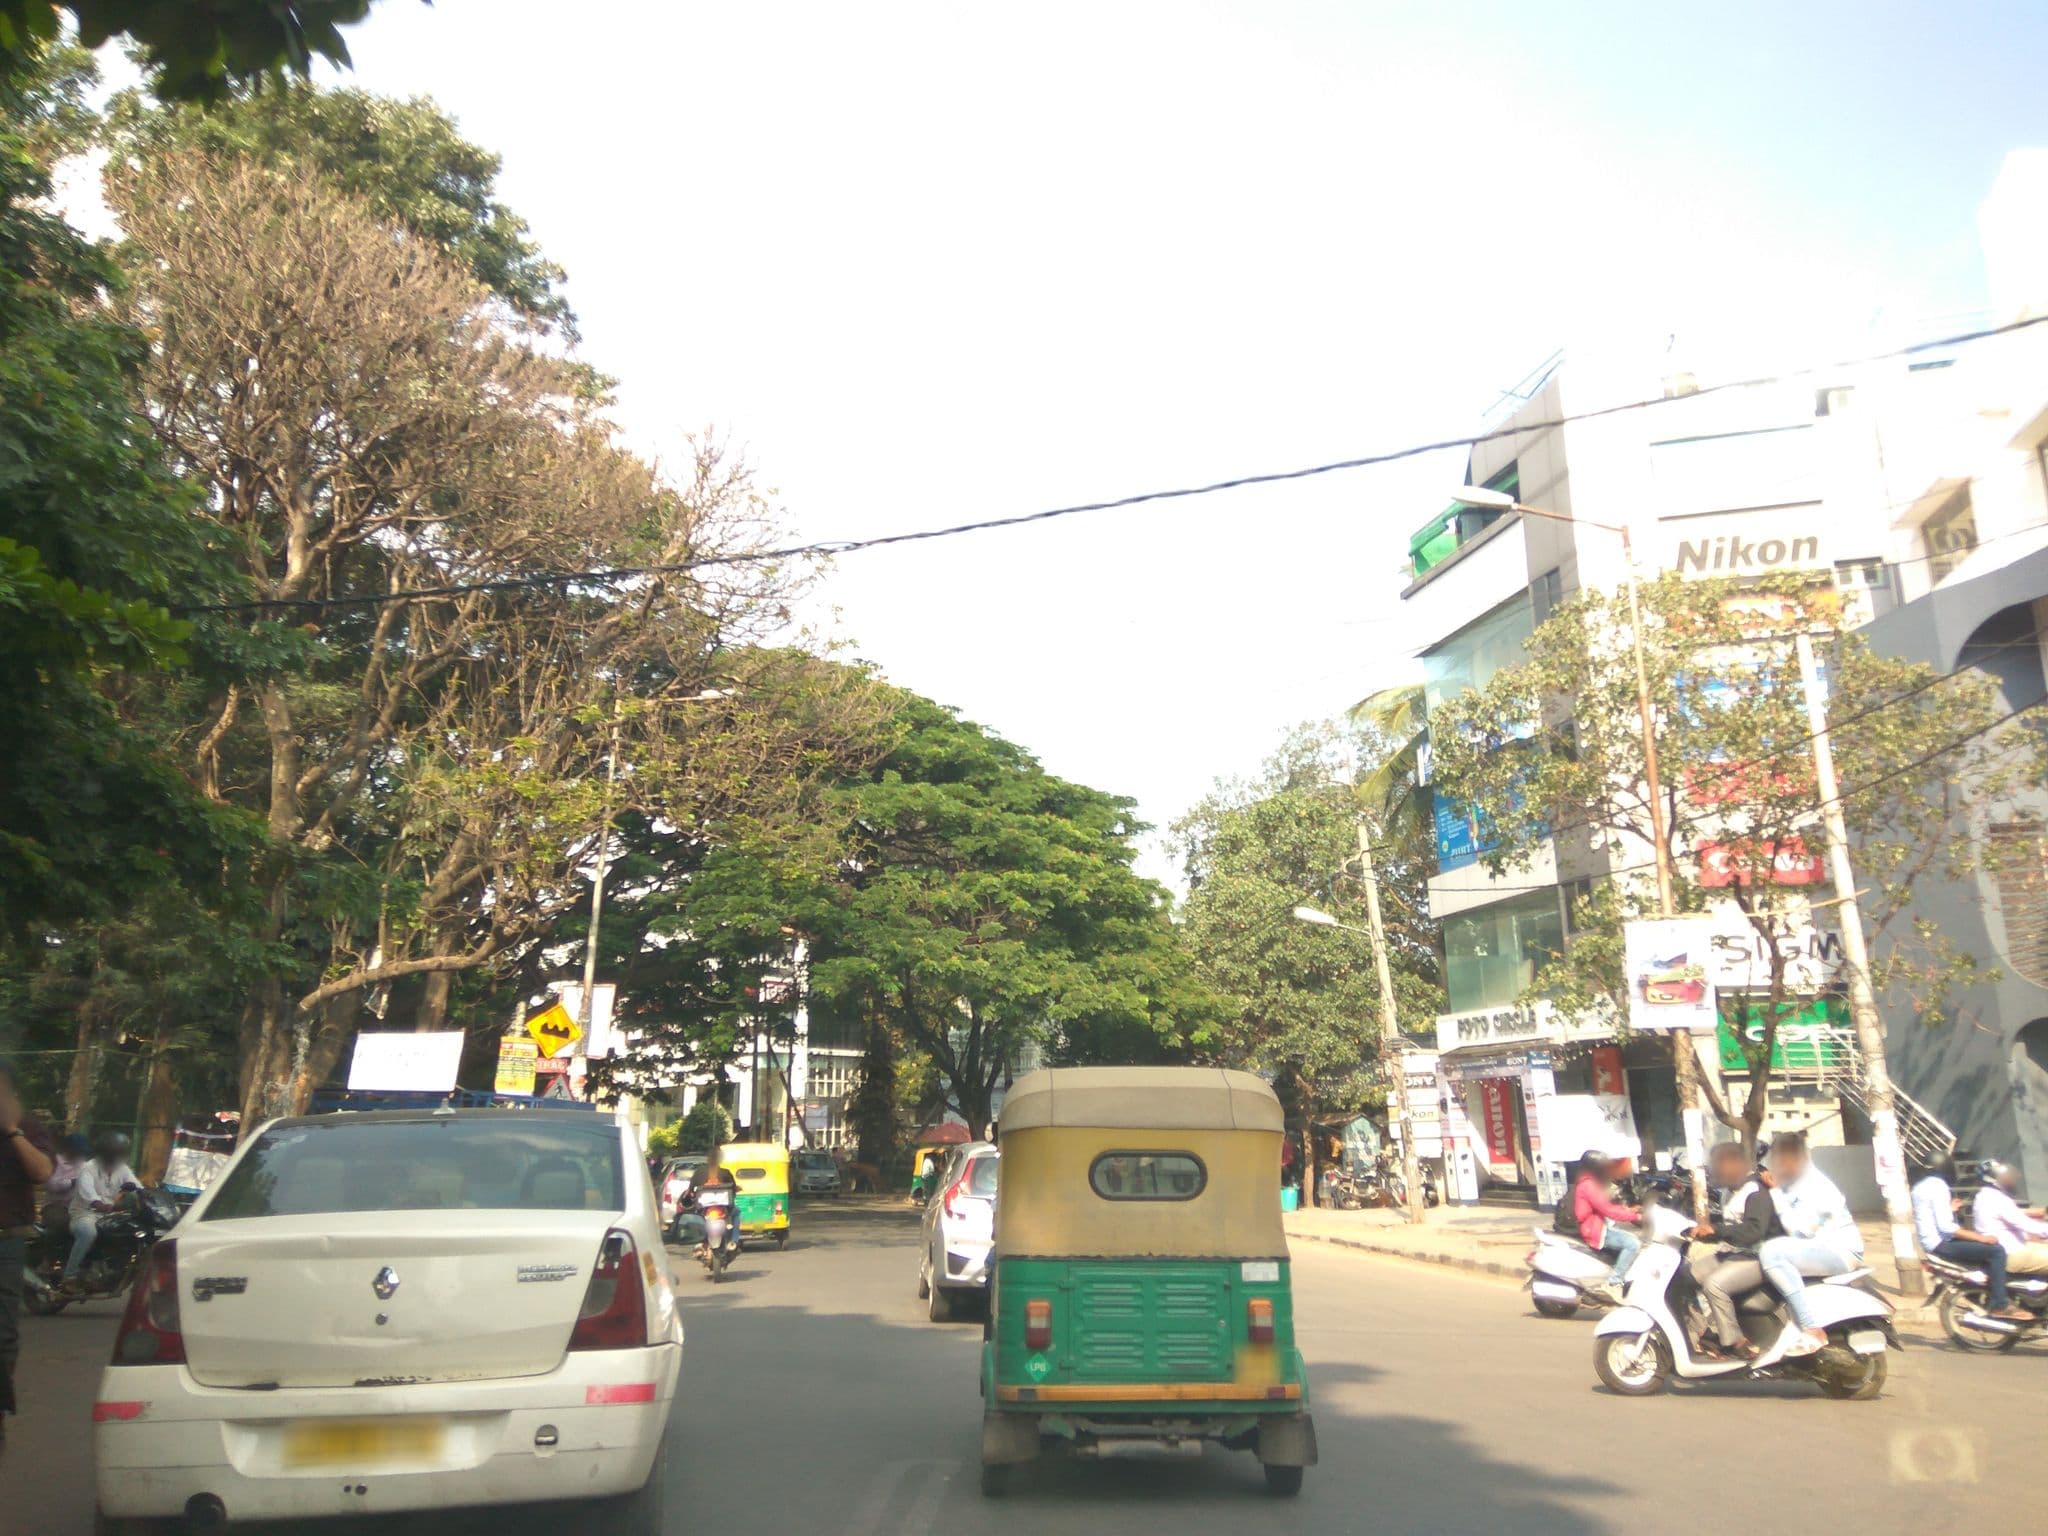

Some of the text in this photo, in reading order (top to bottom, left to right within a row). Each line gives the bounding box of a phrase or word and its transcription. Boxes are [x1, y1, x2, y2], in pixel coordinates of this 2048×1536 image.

[1676, 535, 1818, 572] Nikon
[1717, 933, 1845, 964] SIGM
[1488, 1086, 1508, 1156] anon
